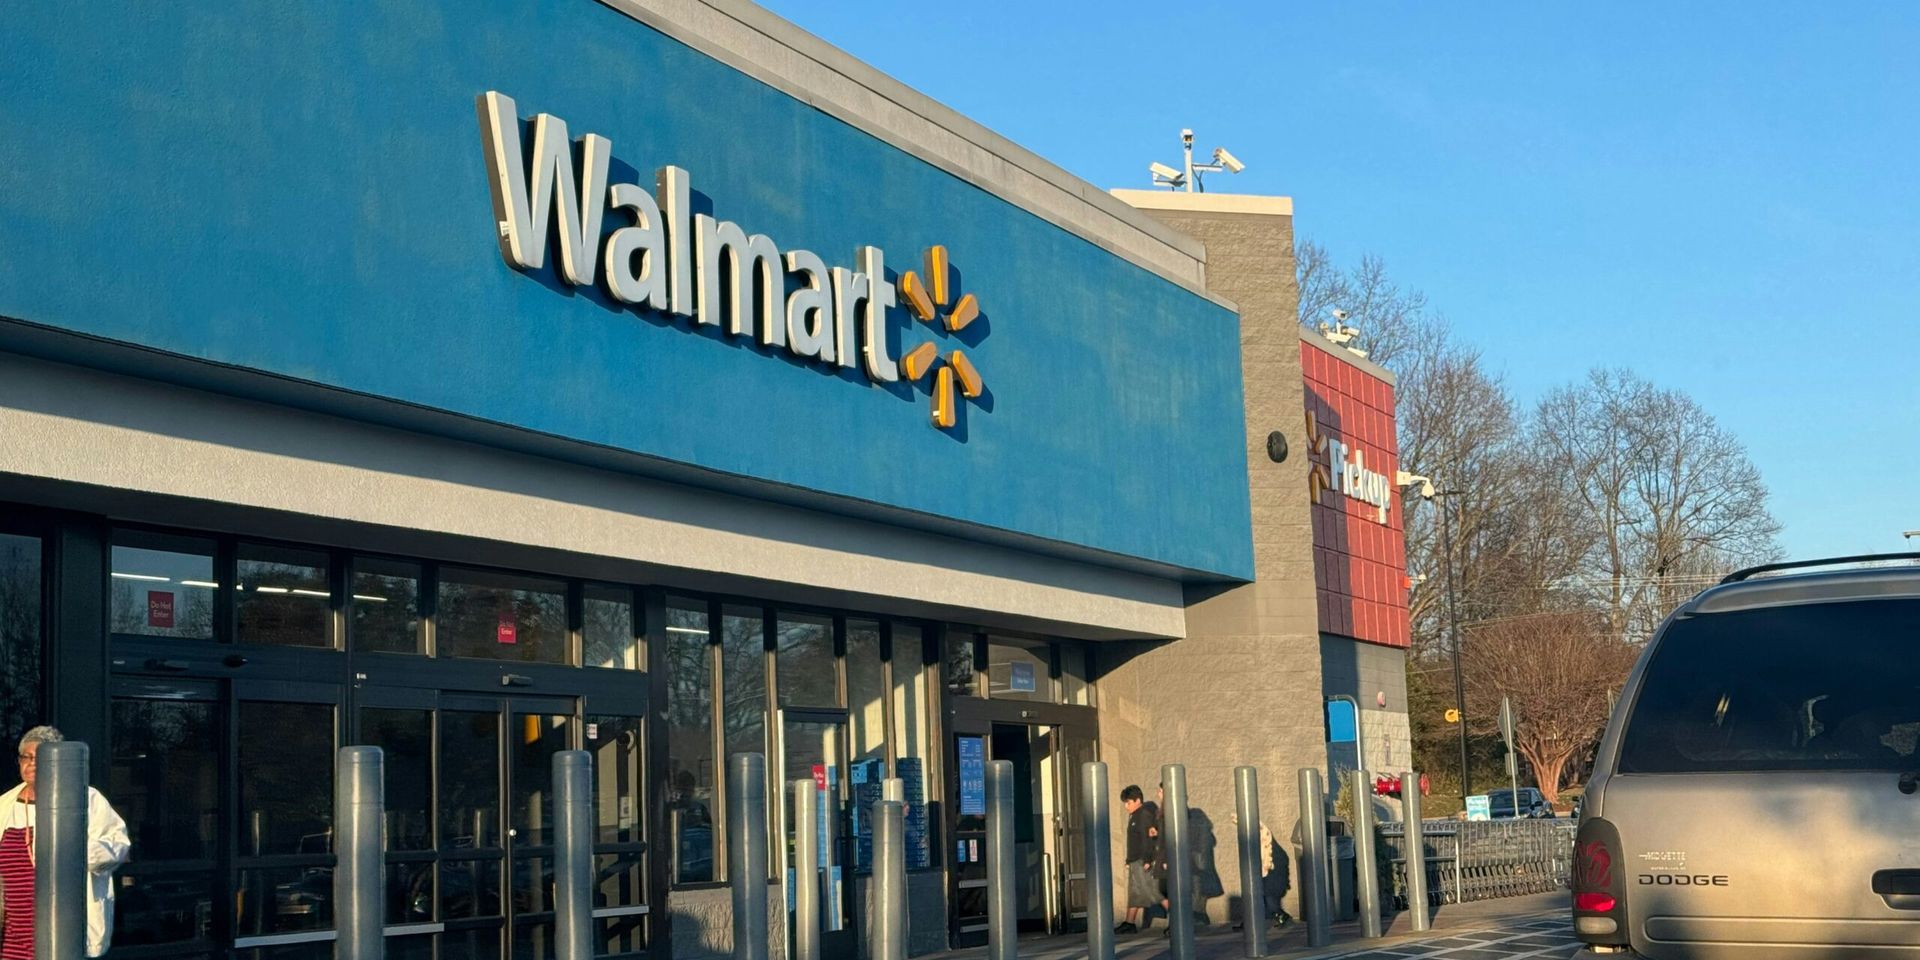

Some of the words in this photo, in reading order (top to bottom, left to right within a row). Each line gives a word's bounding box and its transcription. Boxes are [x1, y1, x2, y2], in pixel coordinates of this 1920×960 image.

[480, 91, 898, 382] Walmart
[1329, 438, 1390, 524] Pickup
[1638, 874, 1729, 887] DODGE
